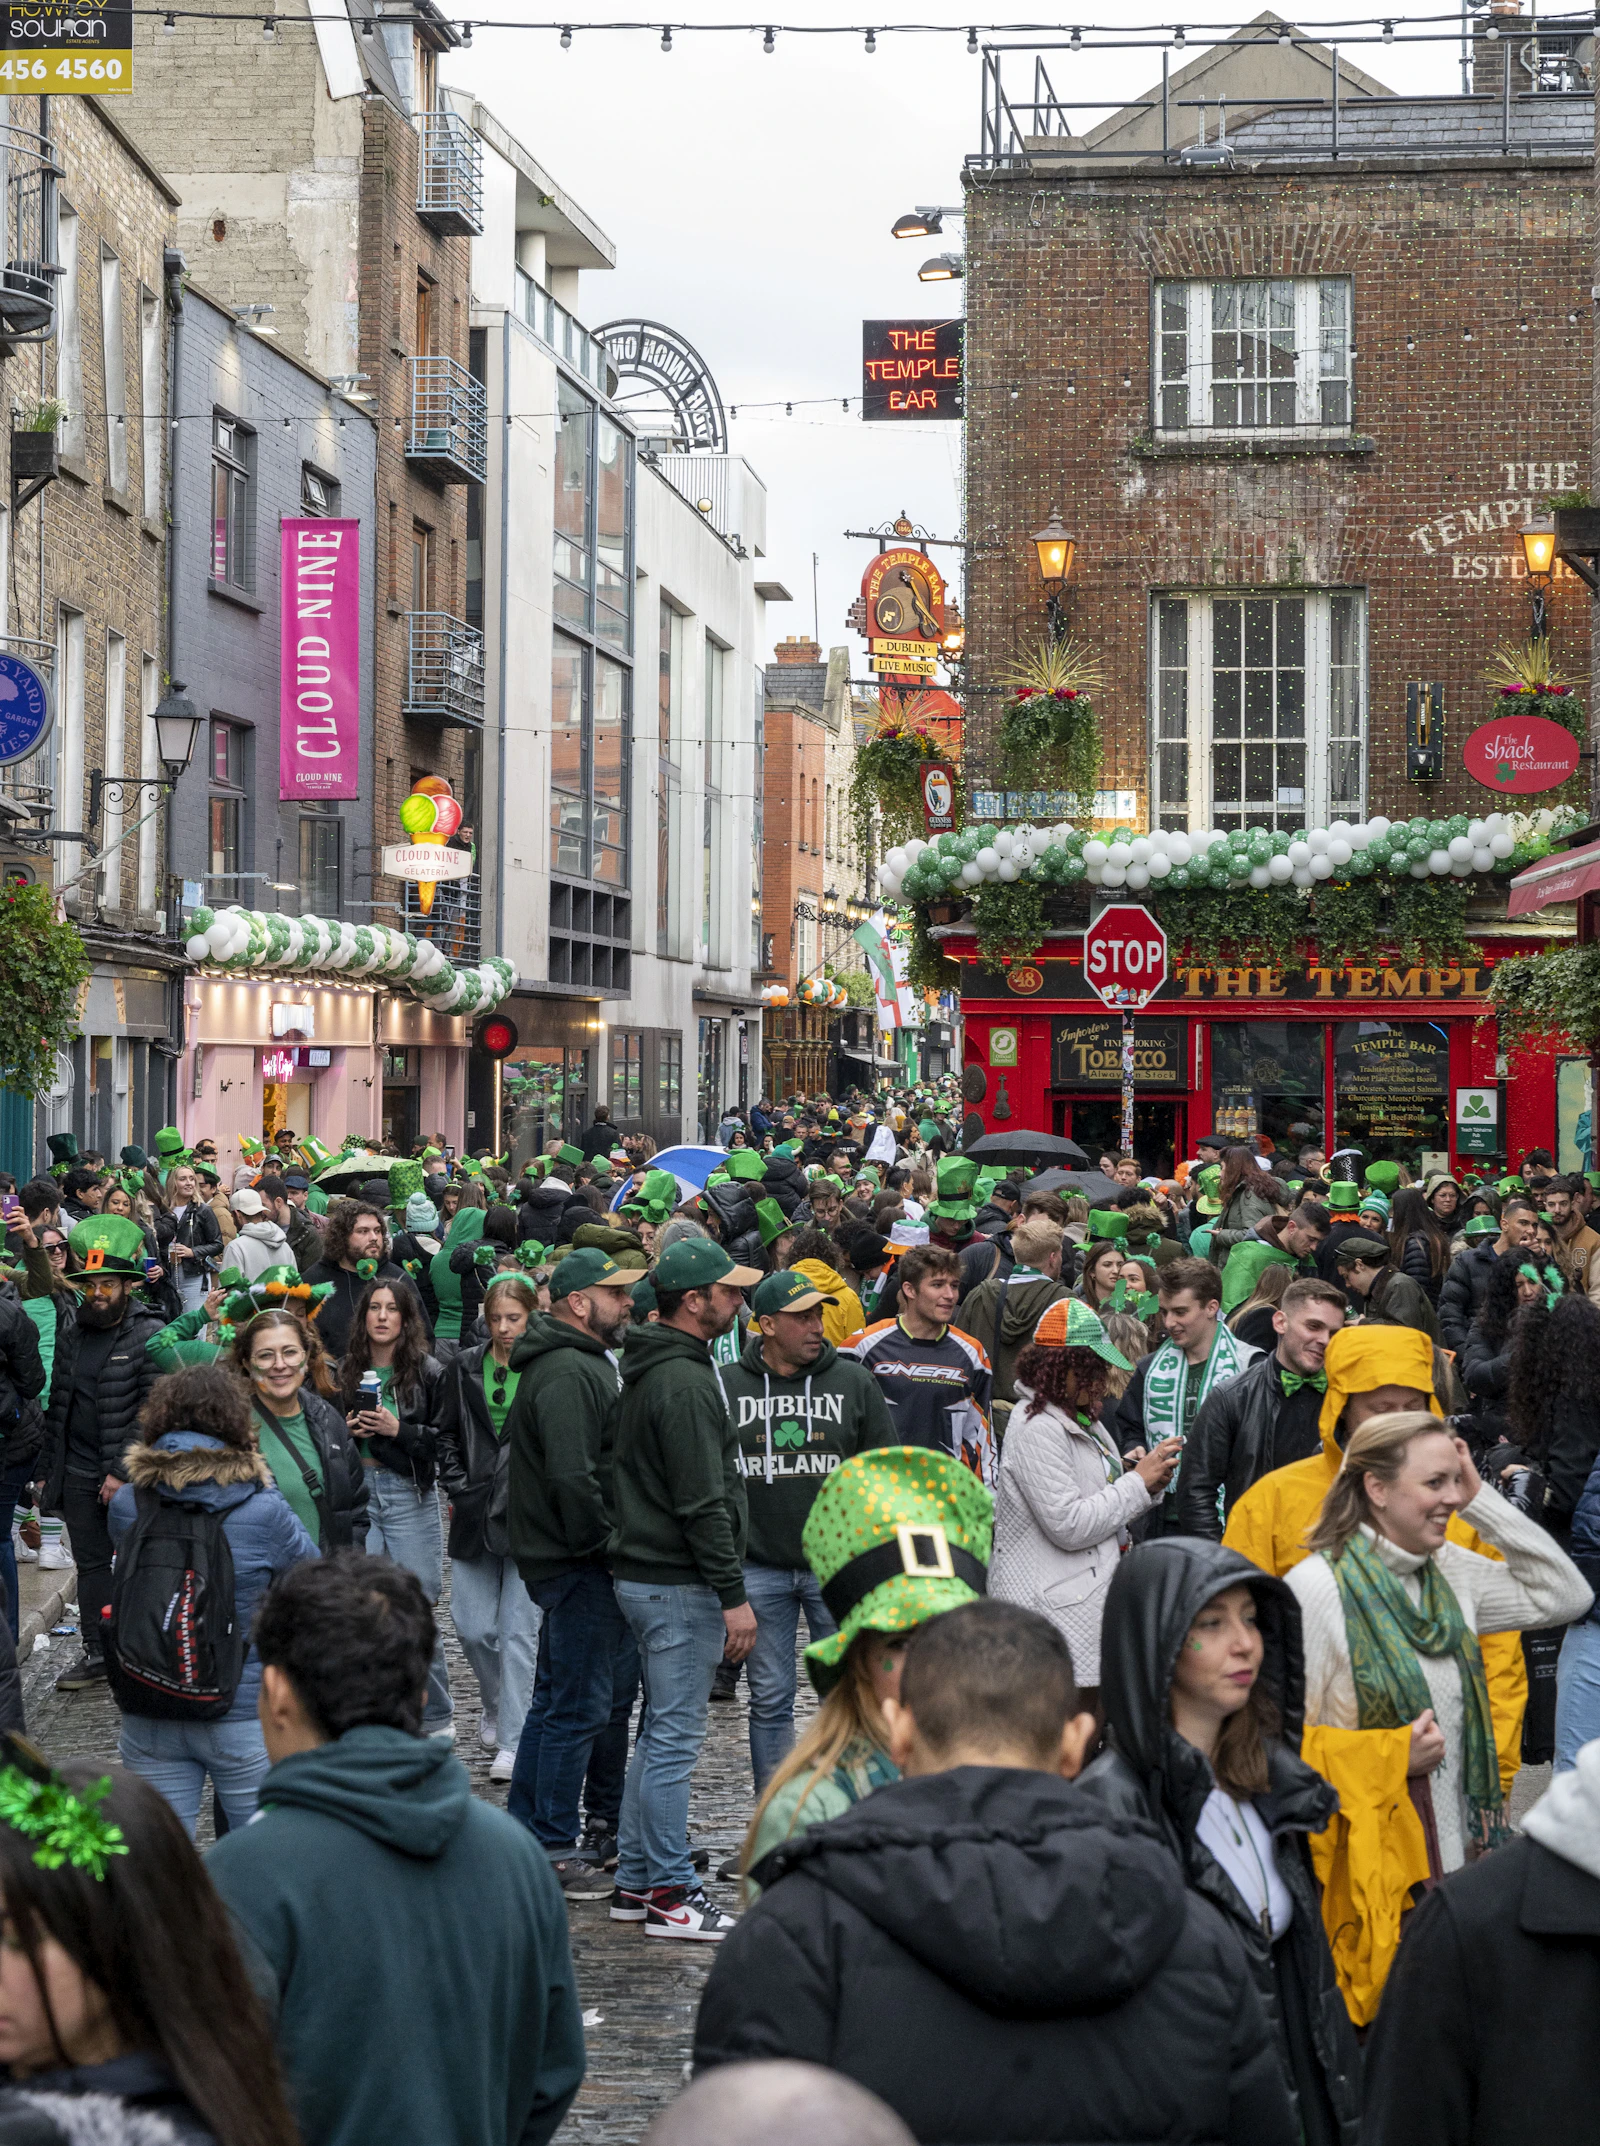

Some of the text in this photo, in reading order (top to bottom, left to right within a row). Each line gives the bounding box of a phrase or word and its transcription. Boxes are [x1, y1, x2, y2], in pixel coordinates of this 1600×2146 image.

[0, 59, 122, 80] 456 4560
[888, 330, 936, 351] THE
[865, 358, 960, 380] TEMPLE
[1500, 463, 1579, 491] THE
[1407, 497, 1555, 555] TEMPL
[869, 552, 942, 606] THE TEMPLE BAR
[296, 531, 343, 758] CLOUD NINE
[886, 641, 926, 654] DUBLIN
[878, 660, 933, 674] LIVE MUSIC
[12, 666, 41, 713] YARD
[5, 712, 39, 728] GARDEN
[1485, 735, 1535, 762] Shack
[1502, 734, 1518, 745] The
[1512, 760, 1569, 770] Restaurant
[296, 773, 342, 783] CLOUD NINE
[395, 850, 459, 864] CLOUD NINE
[404, 868, 450, 876] GELATERIA
[1089, 938, 1162, 974] STOP
[1016, 971, 1036, 988] 48
[1177, 967, 1497, 997] THE TEMPL
[1057, 1022, 1110, 1043] Importers
[1351, 1039, 1436, 1055] TEMPLE BAR
[1071, 1044, 1167, 1076] TOBCCO
[1090, 1070, 1122, 1078] Alway
[1145, 1070, 1174, 1078] Stock
[1572, 1247, 1587, 1268] G
[737, 1393, 845, 1428] DUBLIN
